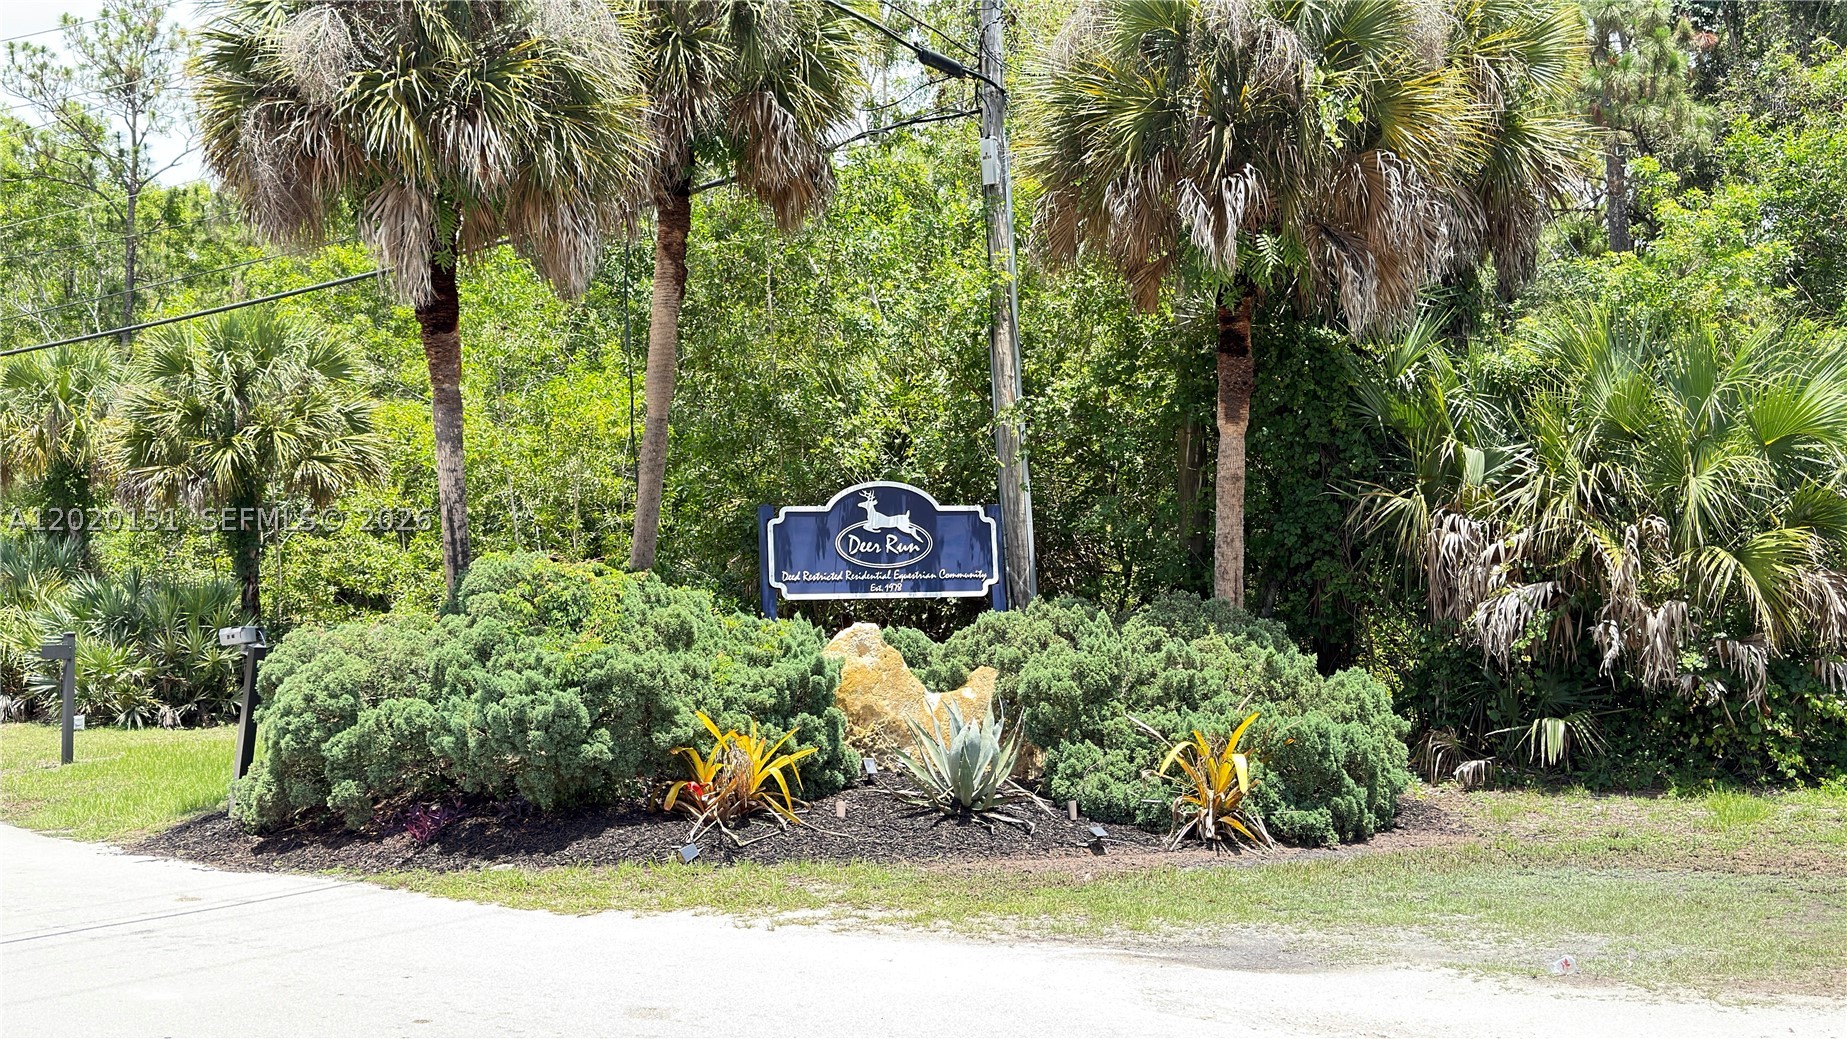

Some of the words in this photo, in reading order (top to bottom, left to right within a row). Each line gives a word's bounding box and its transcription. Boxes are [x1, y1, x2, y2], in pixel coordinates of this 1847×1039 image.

[848, 534, 882, 555] Deer
[885, 533, 920, 554] Run
[781, 570, 801, 582] Deed
[802, 570, 843, 582] Restricted
[845, 569, 891, 581] Residential
[893, 568, 937, 582] Equestrian
[938, 568, 987, 582] Community
[870, 583, 884, 592] Est.
[884, 583, 903, 592] 1978
